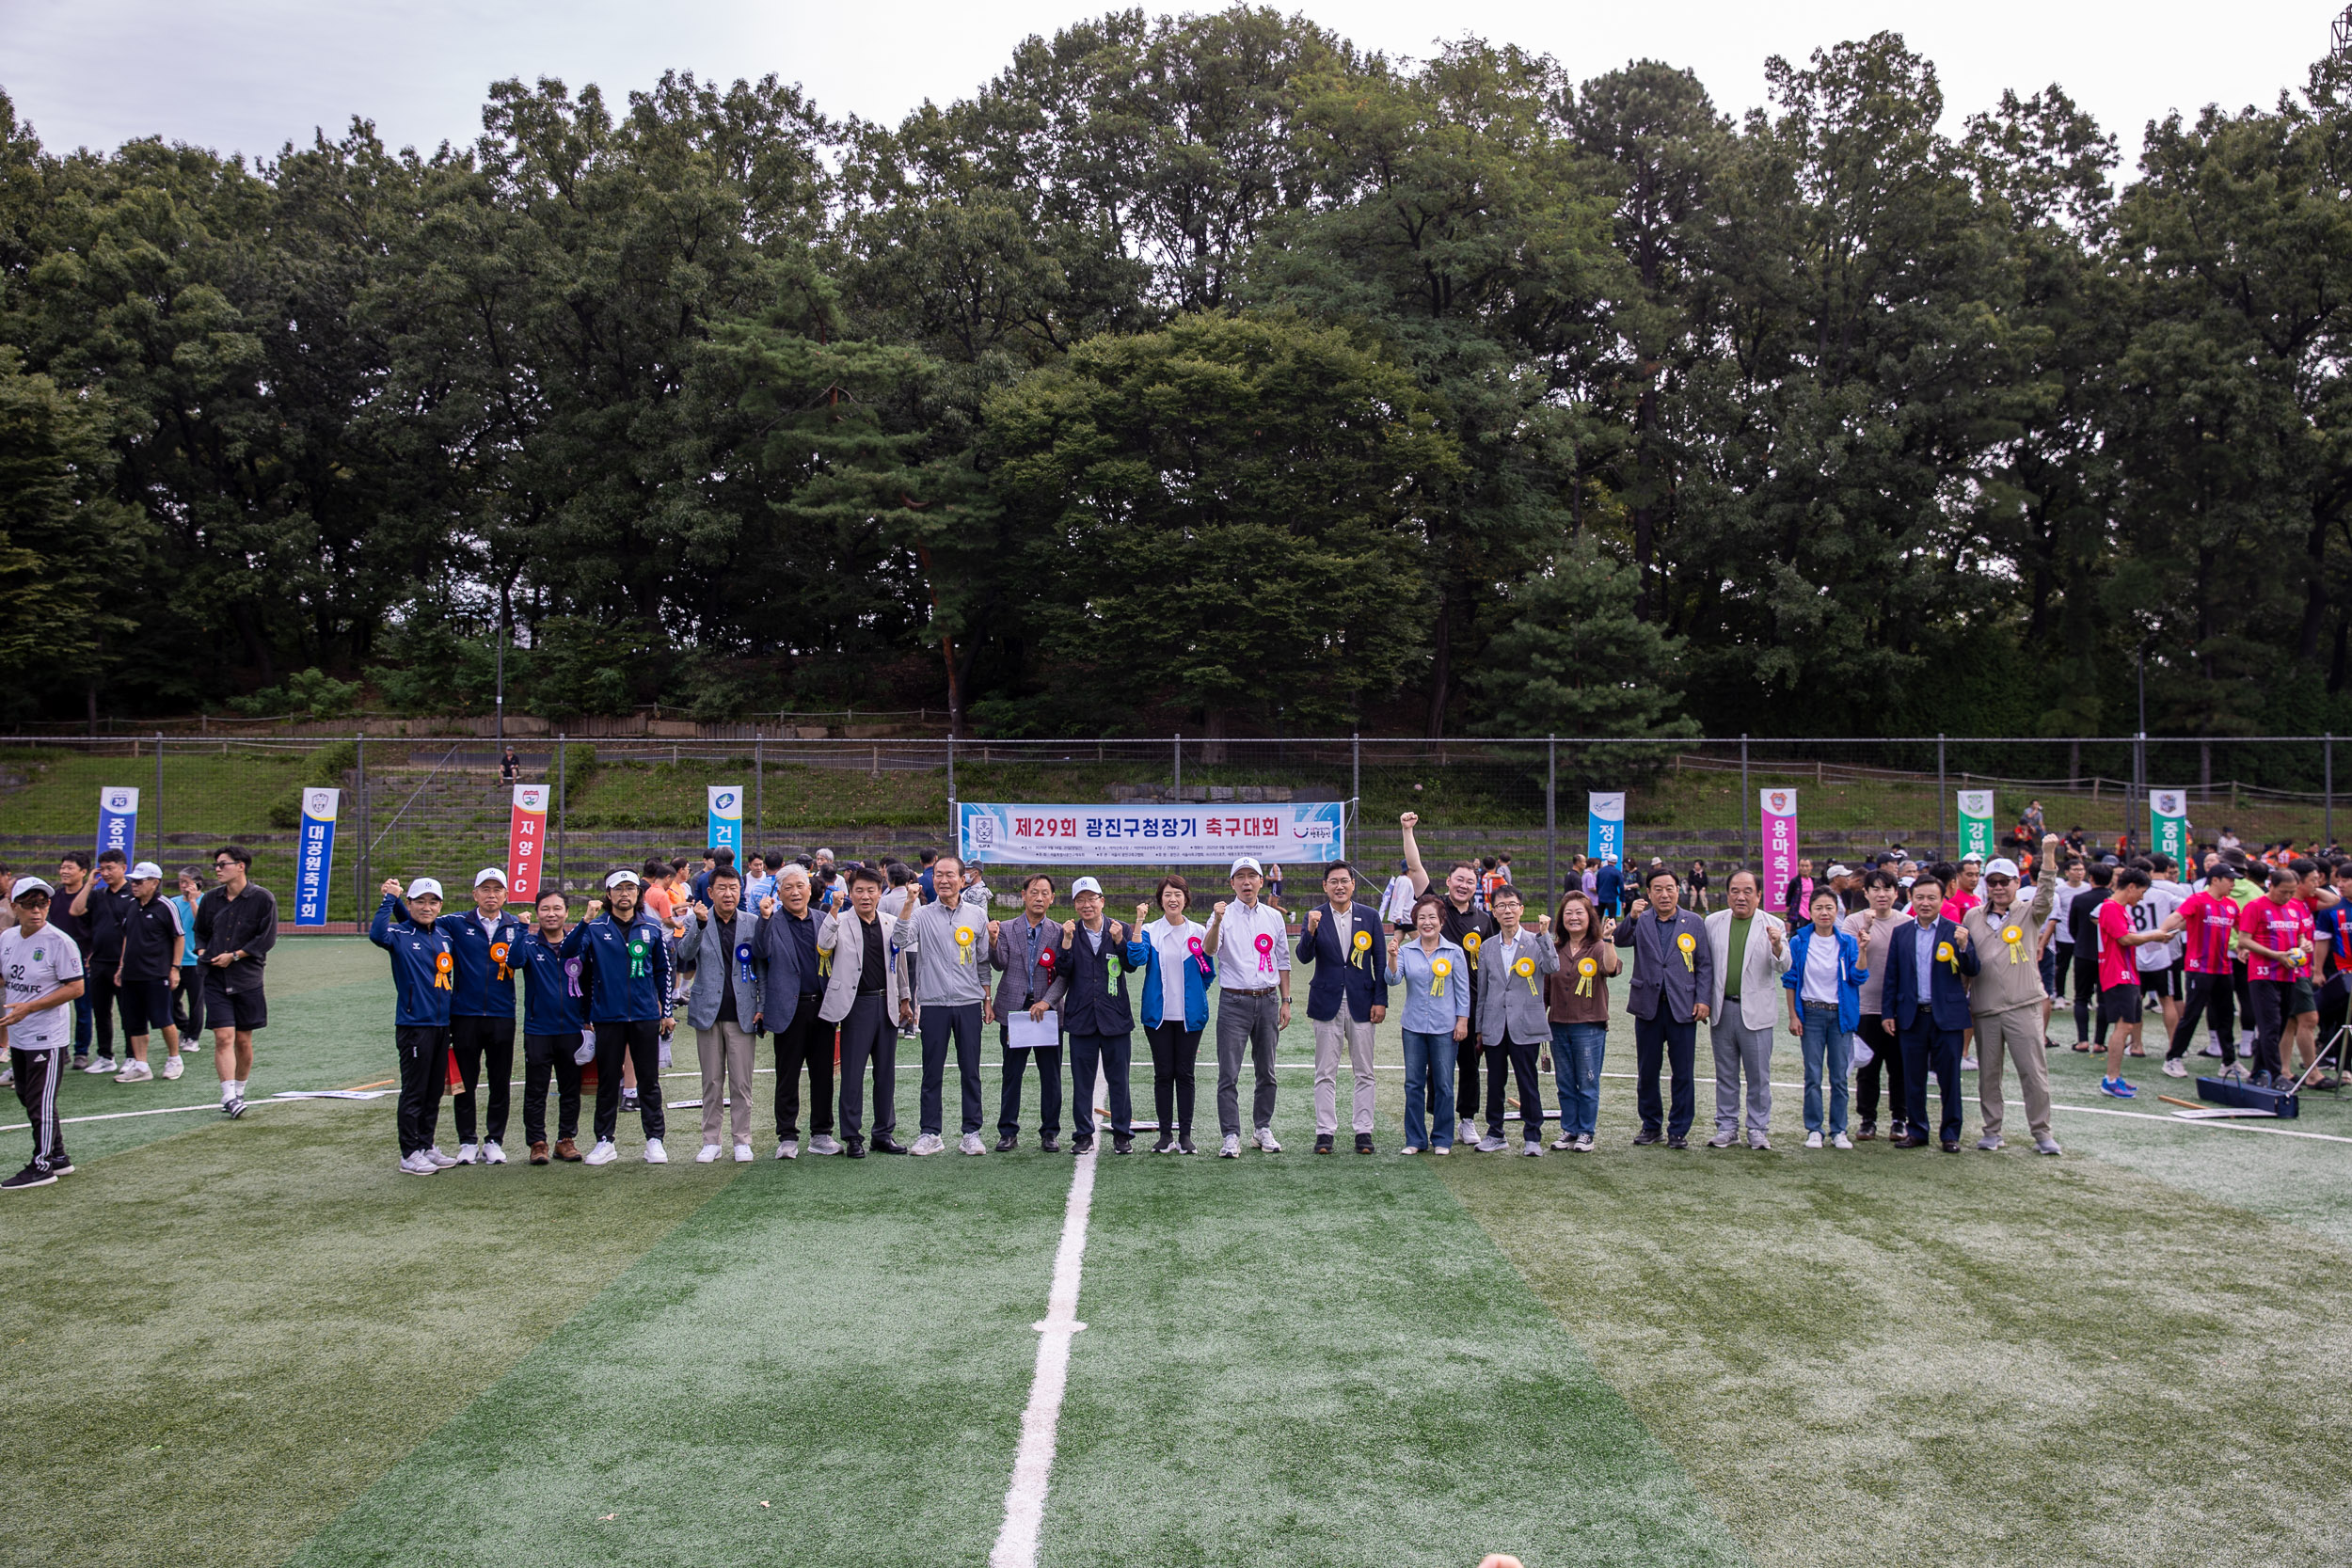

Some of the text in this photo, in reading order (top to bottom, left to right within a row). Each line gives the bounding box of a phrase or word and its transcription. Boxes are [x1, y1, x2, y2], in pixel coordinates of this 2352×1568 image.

[716, 826, 732, 848] 건
[1015, 816, 1279, 837] 제29회 광진구청장기 축구대회
[2162, 821, 2179, 860] 중마
[1599, 825, 1615, 866] 정립
[301, 826, 325, 918] 대공원축구회
[1772, 820, 1789, 905] 용마축구회
[2131, 903, 2158, 931] 81
[10, 964, 25, 980] 32
[2257, 966, 2270, 975] 33
